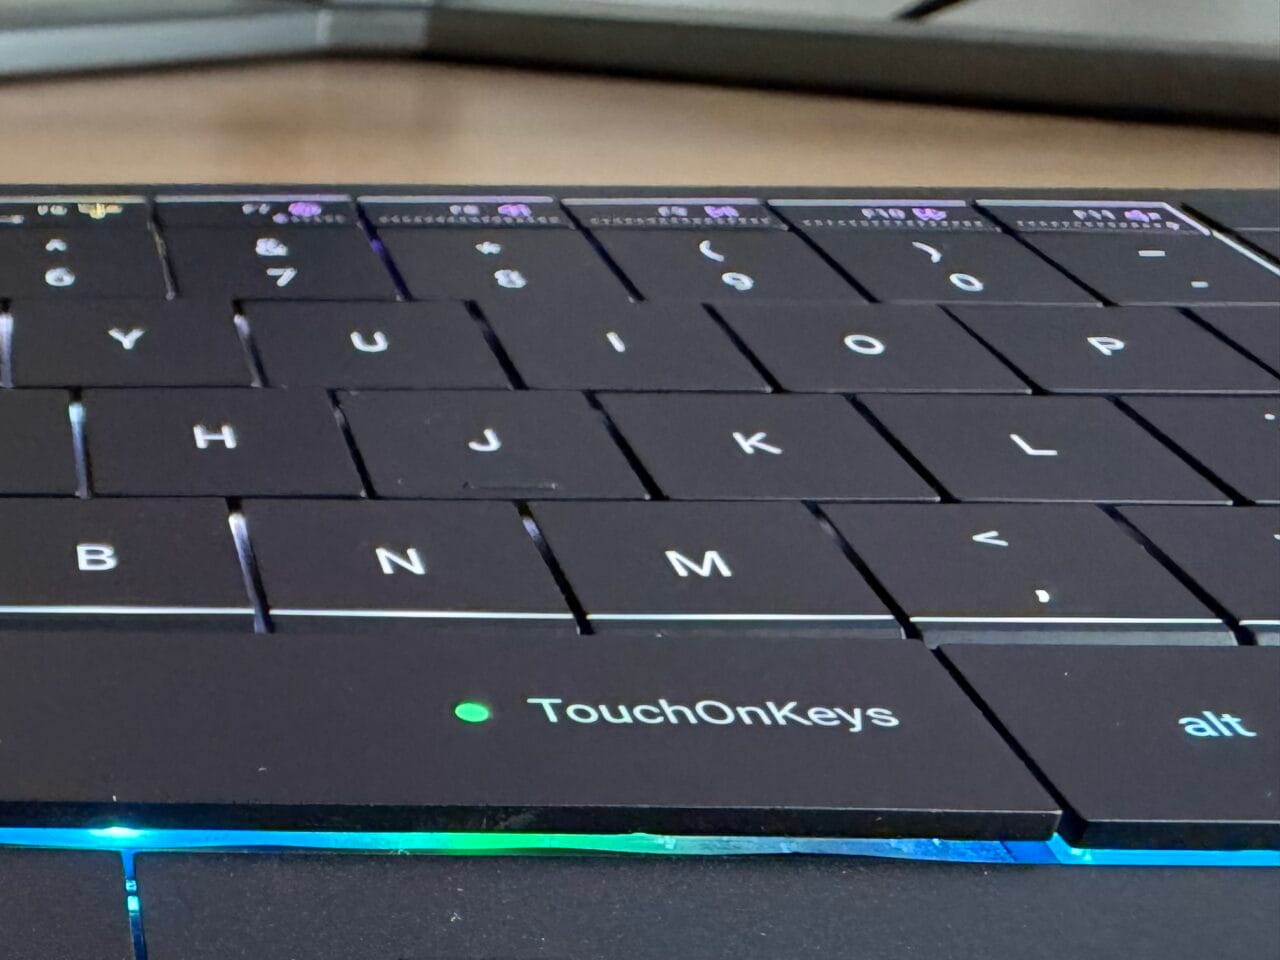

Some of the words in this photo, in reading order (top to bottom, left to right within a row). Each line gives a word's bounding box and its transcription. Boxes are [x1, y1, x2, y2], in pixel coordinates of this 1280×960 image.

[44, 267, 76, 287] 6
[266, 267, 297, 287] 7
[721, 272, 754, 291] 9
[108, 328, 144, 350] Y
[350, 331, 389, 353] U
[606, 331, 626, 353] I
[844, 334, 885, 355] O
[1087, 336, 1125, 356] P
[193, 425, 237, 449] H
[468, 428, 502, 452] J
[732, 431, 783, 455] K
[1009, 433, 1058, 456] L
[76, 543, 118, 571] B
[375, 547, 426, 575] N
[664, 550, 732, 578] M
[526, 697, 900, 733] TouchOnKeys
[1178, 710, 1257, 737] alt
